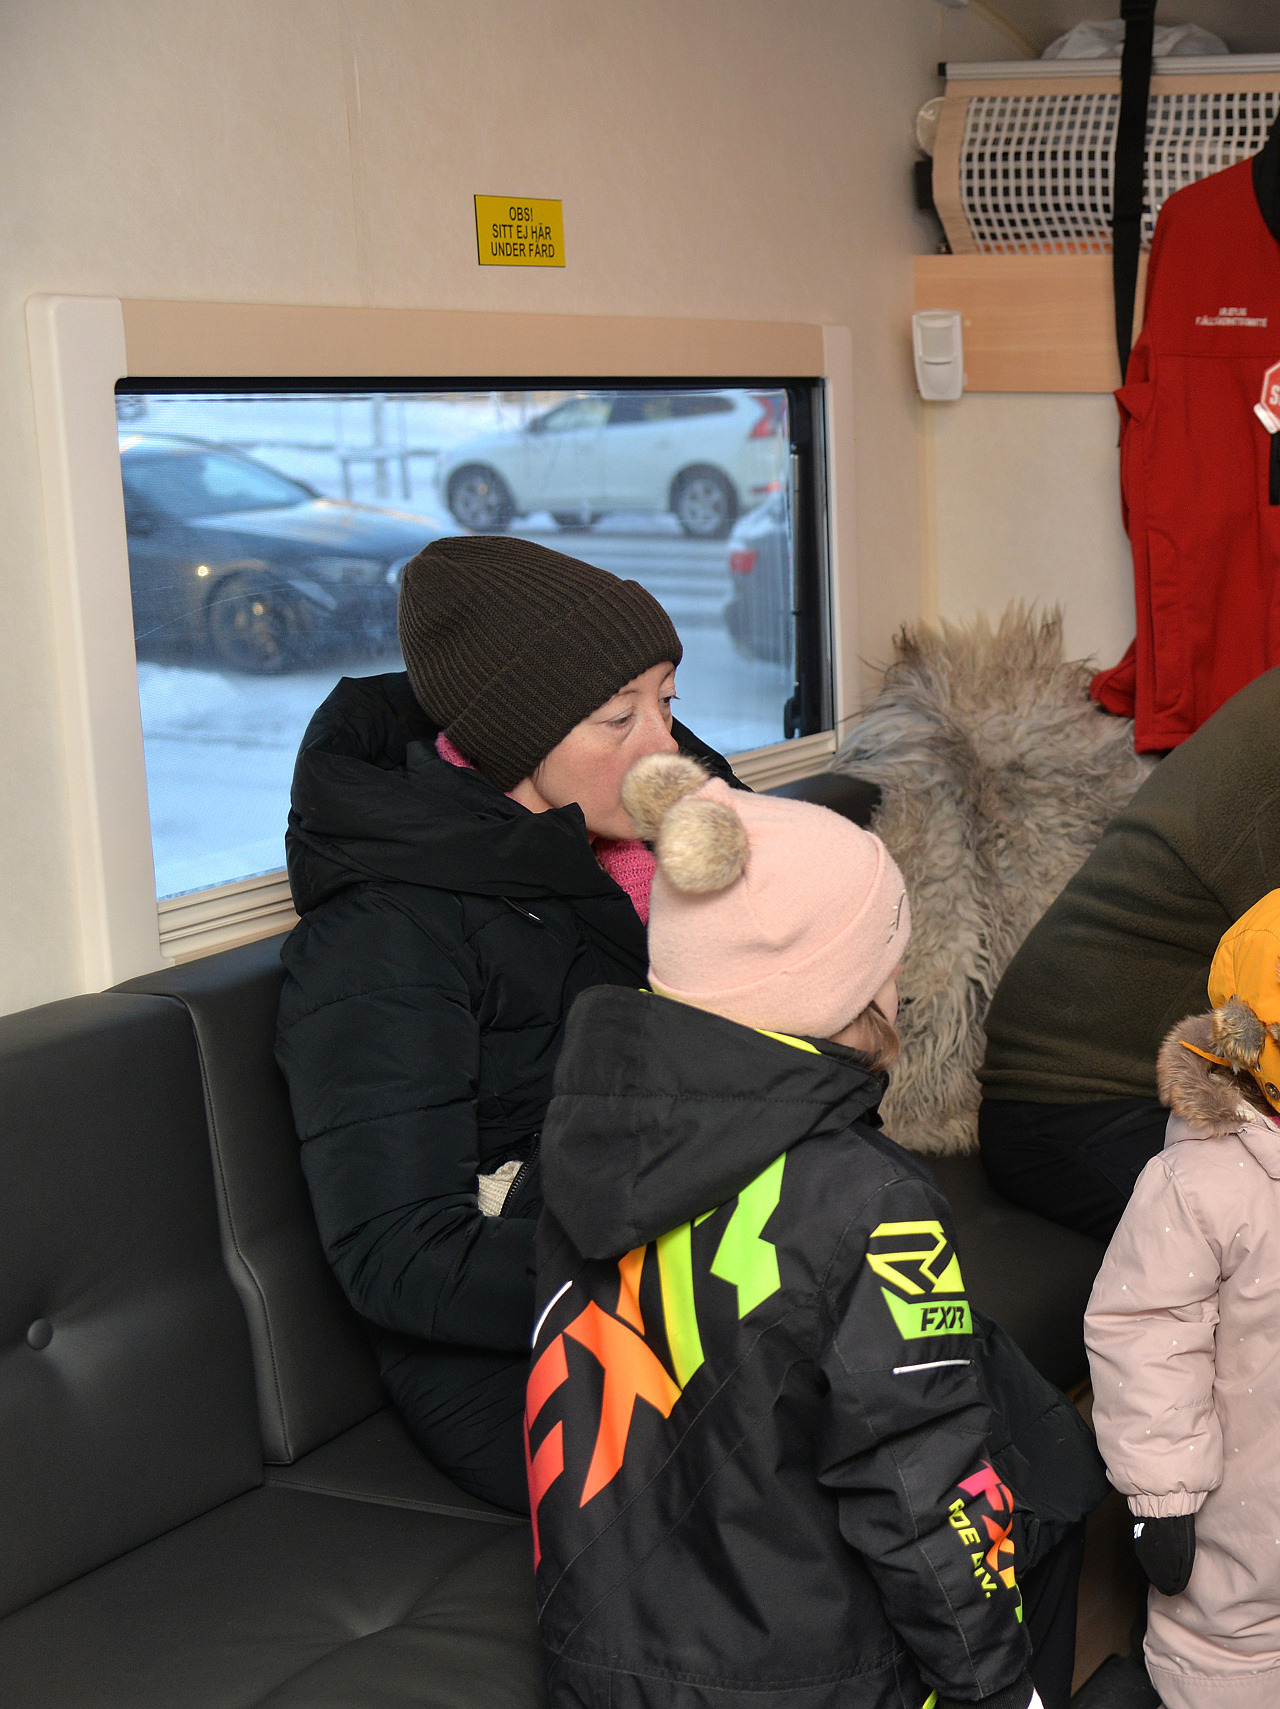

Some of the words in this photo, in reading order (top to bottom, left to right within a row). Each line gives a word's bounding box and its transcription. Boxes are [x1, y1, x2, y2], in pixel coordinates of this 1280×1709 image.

[509, 206, 533, 221] OBS!
[492, 223, 513, 238] SITT
[516, 225, 528, 239] EJ
[531, 222, 552, 240] HÄR
[491, 242, 526, 257] UNDER
[528, 240, 555, 258] FÄRD
[920, 1306, 965, 1332] FXR
